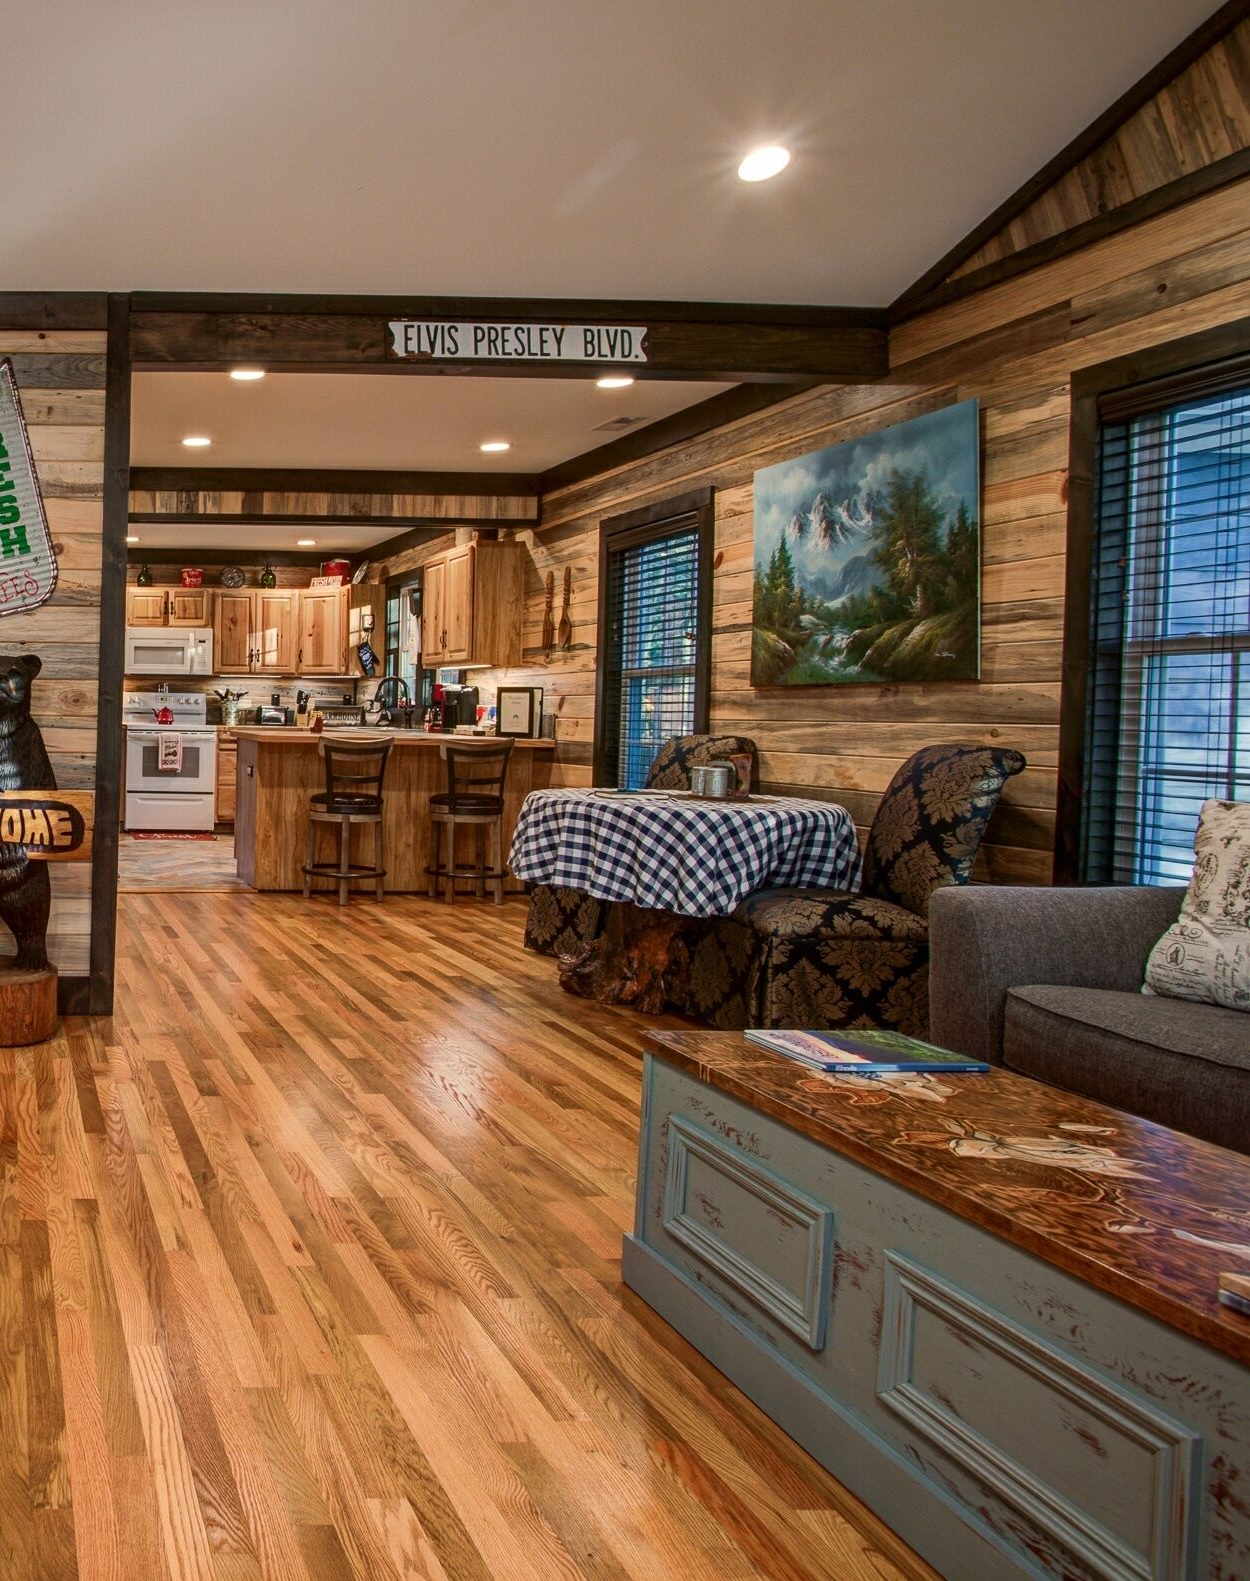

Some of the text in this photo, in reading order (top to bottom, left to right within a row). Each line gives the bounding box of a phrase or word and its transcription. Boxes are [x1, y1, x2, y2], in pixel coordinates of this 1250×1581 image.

[403, 324, 639, 359] ELVIS PRESLEY BLVD.
